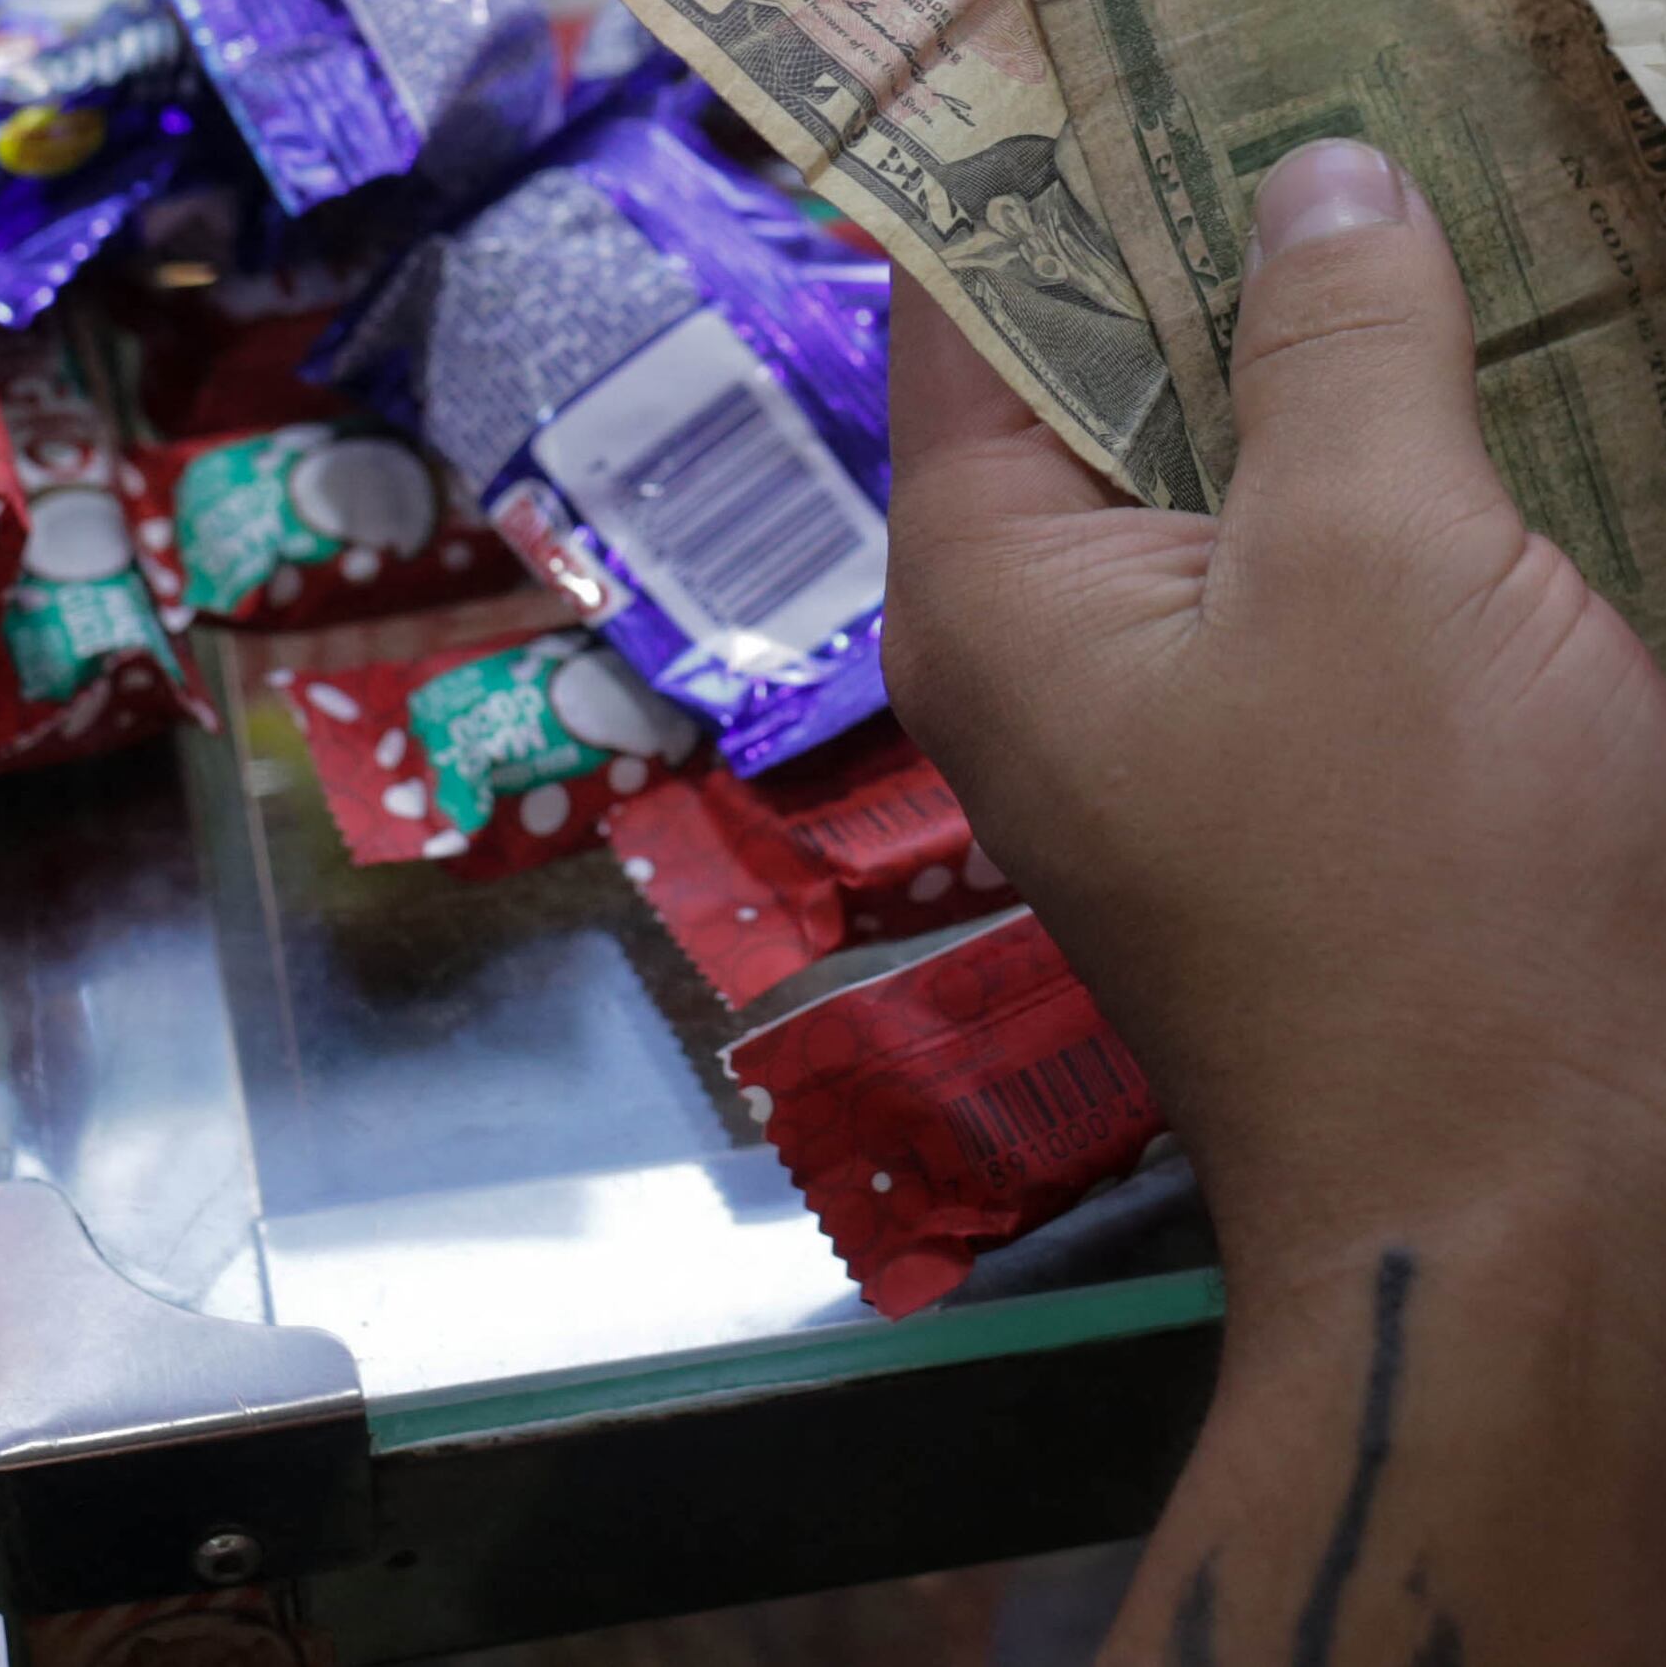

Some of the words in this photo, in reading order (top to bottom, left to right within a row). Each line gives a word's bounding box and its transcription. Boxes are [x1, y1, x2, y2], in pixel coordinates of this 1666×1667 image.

[1558, 153, 1591, 191] IN
[1587, 198, 1635, 279] GOD
[1627, 284, 1656, 345] WE
